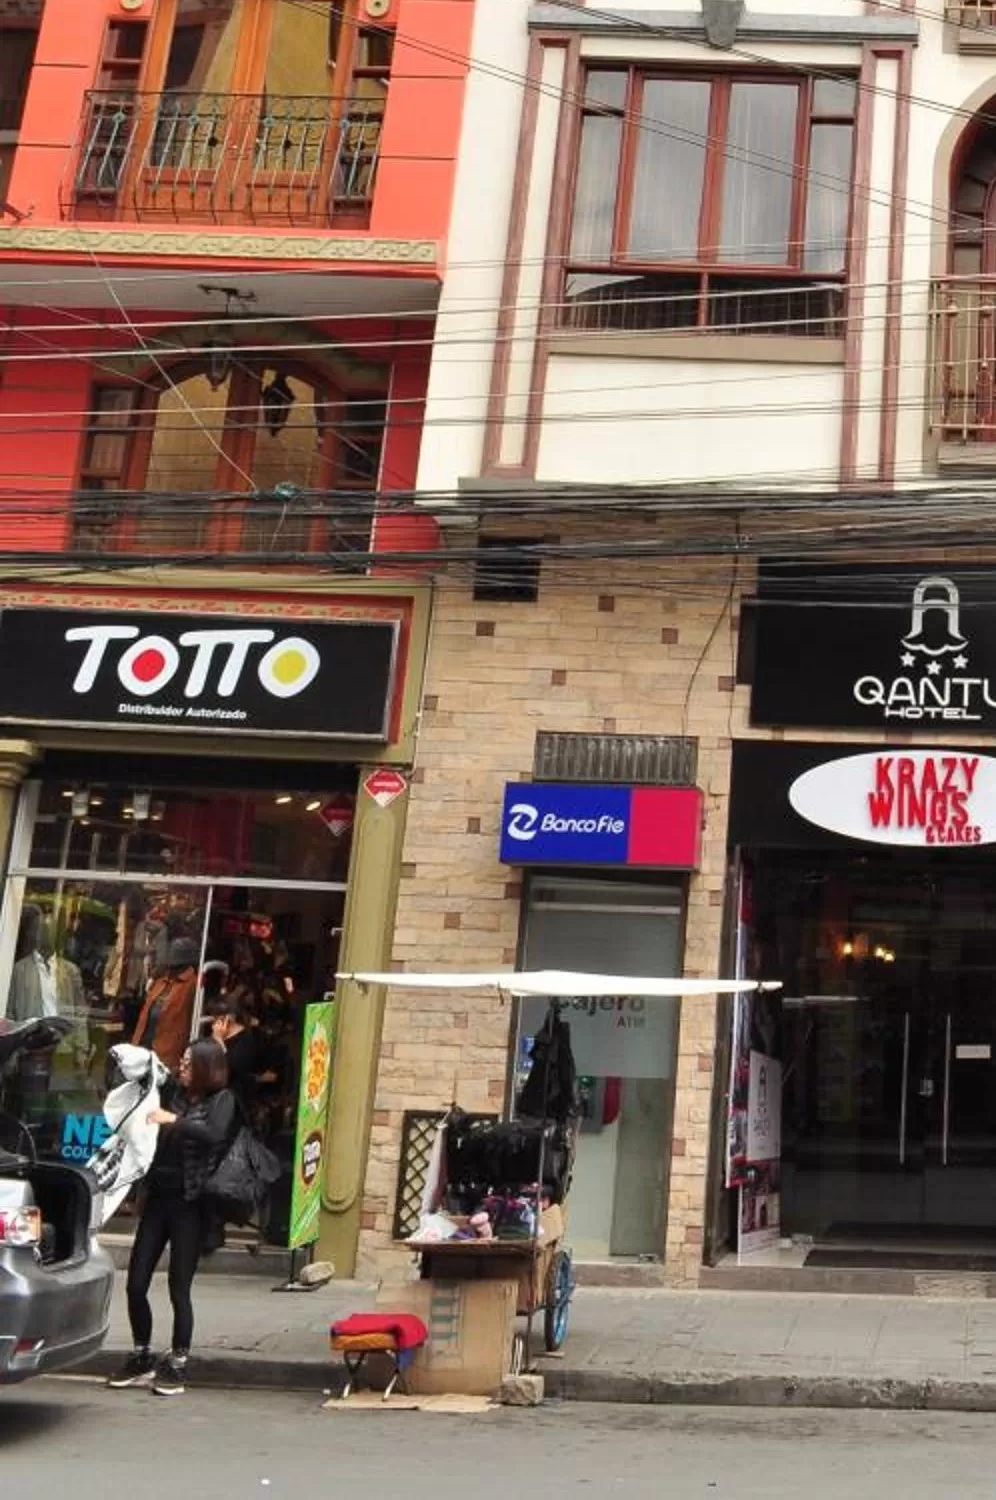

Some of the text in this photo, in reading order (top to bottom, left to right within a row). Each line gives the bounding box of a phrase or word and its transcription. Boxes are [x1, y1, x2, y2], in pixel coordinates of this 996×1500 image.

[65, 626, 320, 698] TOTTO
[118, 703, 247, 720] Distribuidor Autorizado
[884, 707, 982, 720] HOTEL
[875, 757, 980, 795] KRAZY
[867, 790, 970, 830] WINGS
[937, 826, 982, 843] CAKES
